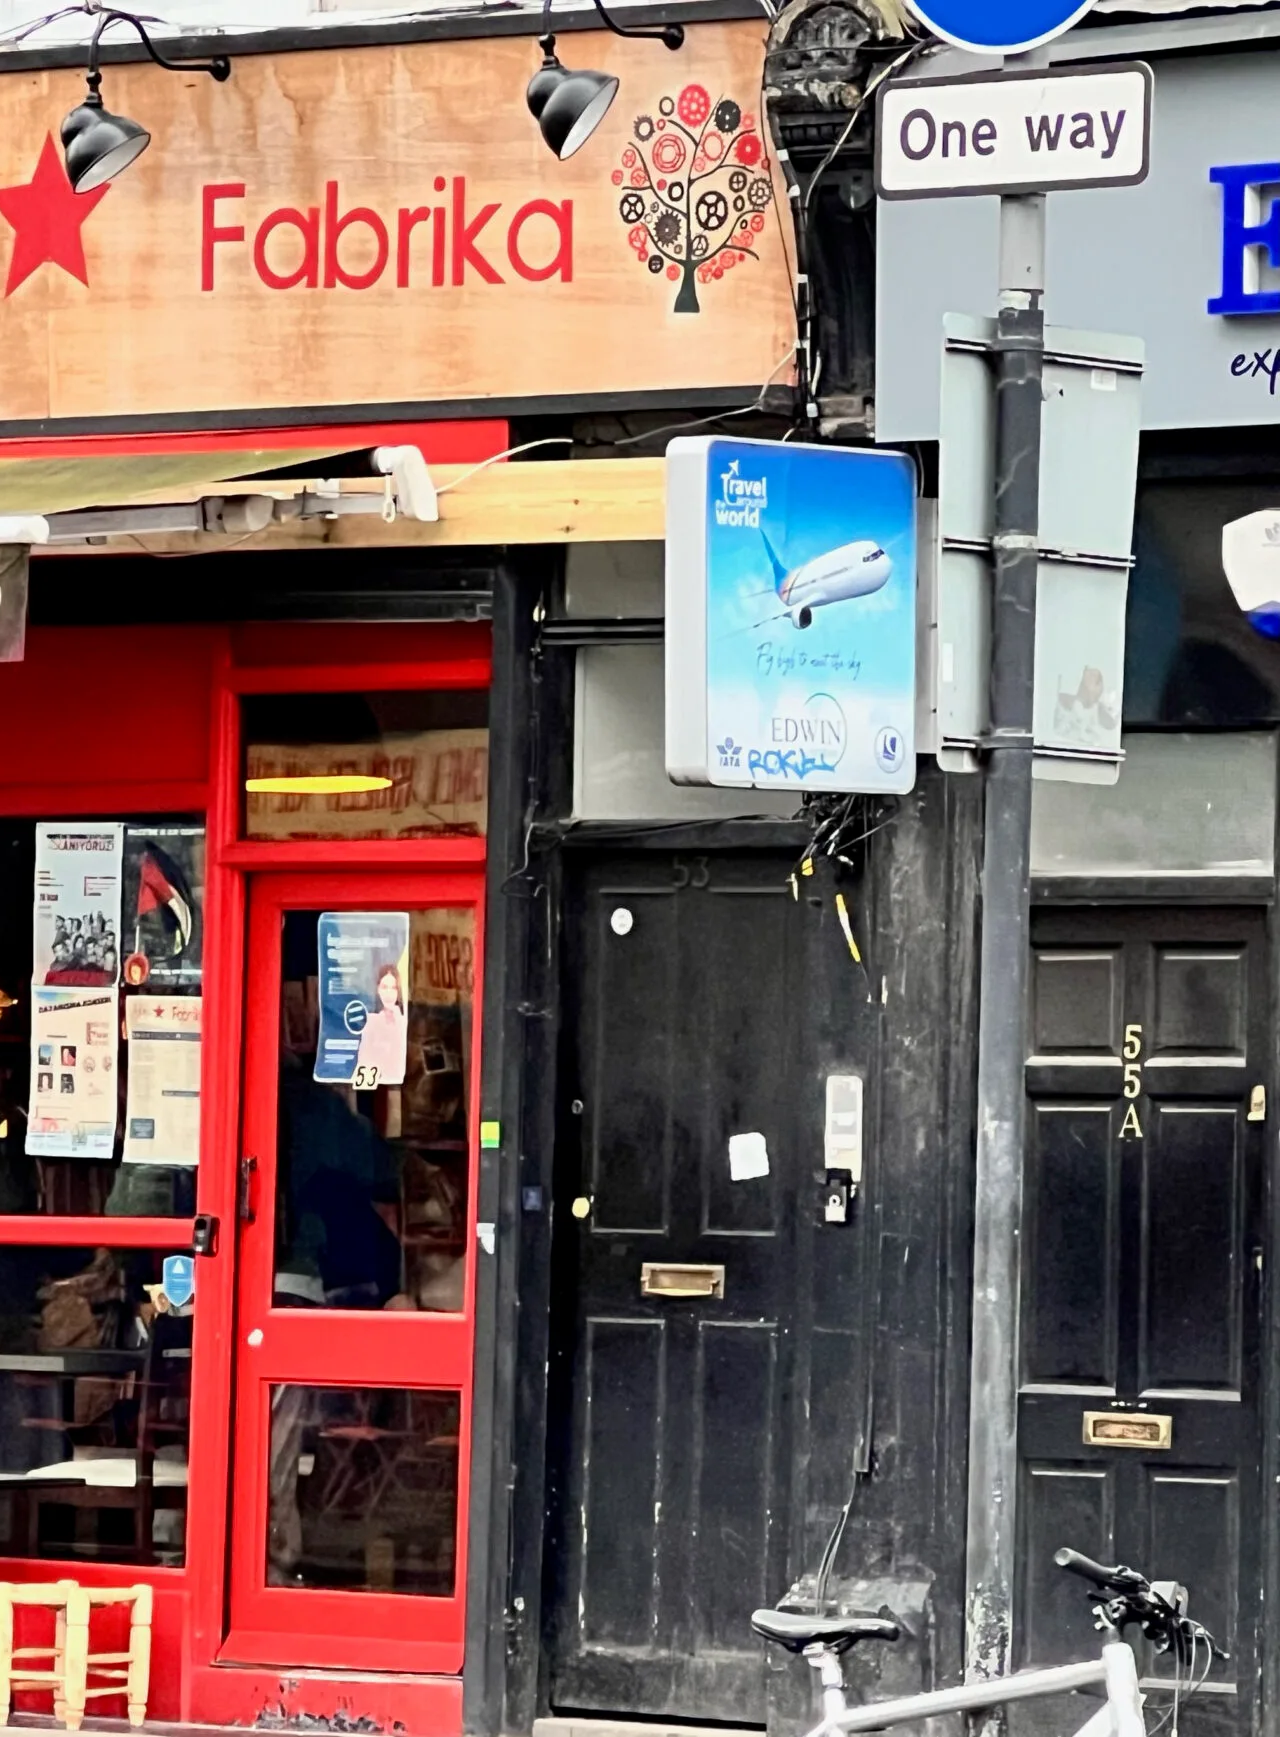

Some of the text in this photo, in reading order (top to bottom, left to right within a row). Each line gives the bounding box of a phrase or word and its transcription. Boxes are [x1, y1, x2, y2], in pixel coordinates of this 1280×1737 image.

[899, 108, 1126, 160] One way
[201, 176, 574, 291] Fabrika
[720, 472, 767, 500] Travel
[716, 505, 759, 528] world
[772, 717, 841, 746] EDWIN
[720, 757, 740, 768] IATA
[672, 855, 710, 888] 53
[355, 1066, 378, 1087] 53
